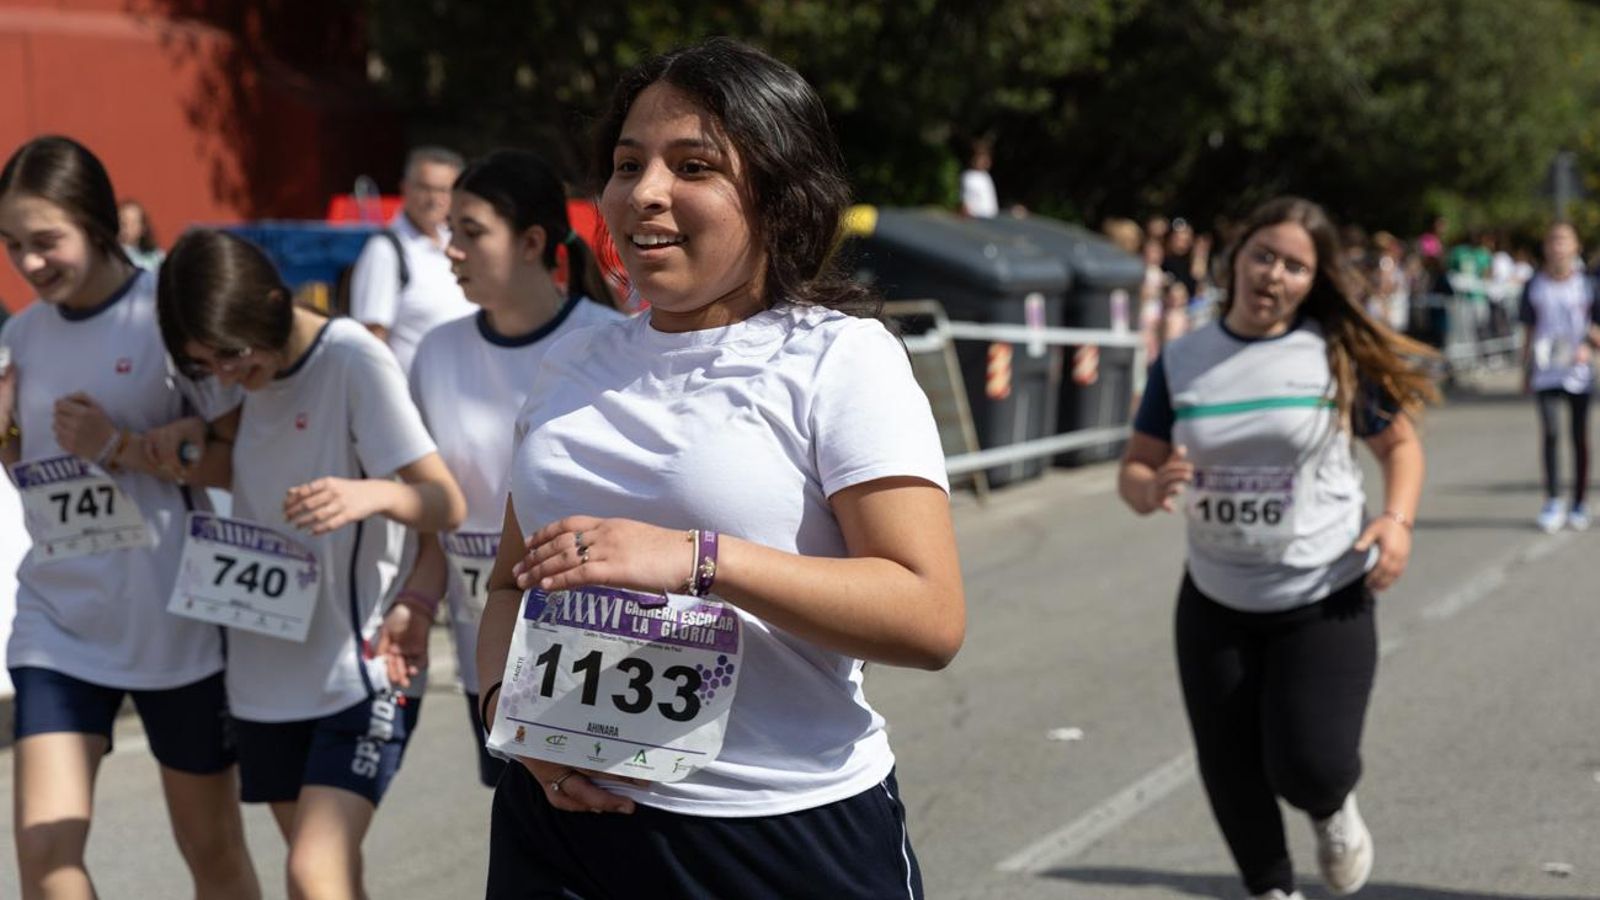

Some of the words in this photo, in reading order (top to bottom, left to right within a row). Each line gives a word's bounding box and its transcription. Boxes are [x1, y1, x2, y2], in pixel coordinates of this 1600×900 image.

[50, 485, 114, 522] 747
[1195, 498, 1282, 526] 1056
[213, 553, 287, 598] 740
[632, 616, 649, 634] LA
[661, 621, 716, 645] GLORIA
[681, 610, 734, 632] ESCOLAR
[535, 643, 702, 722] 1133
